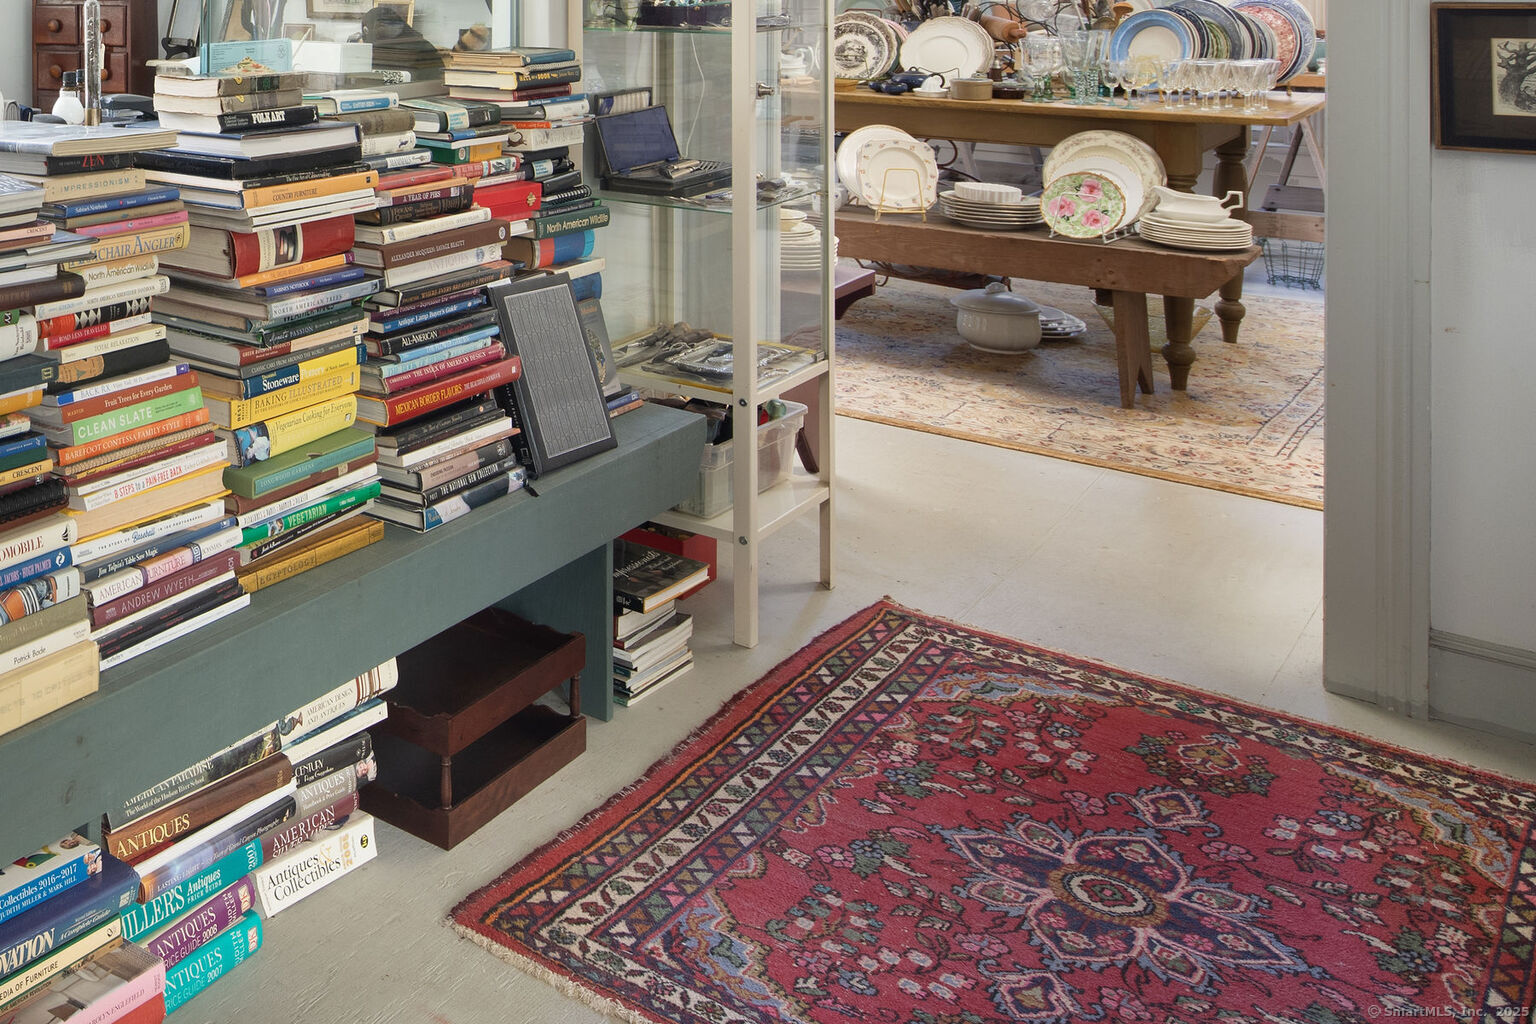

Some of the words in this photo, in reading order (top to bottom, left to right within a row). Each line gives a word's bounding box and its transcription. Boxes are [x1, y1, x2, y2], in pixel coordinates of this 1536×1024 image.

[252, 112, 270, 124] FOLK
[270, 110, 285, 122] ART
[82, 154, 105, 168] ZEN
[61, 177, 130, 193] IMPRESSIONISM
[273, 192, 293, 202] COUNTRY
[409, 193, 422, 202] YEAR
[429, 190, 441, 199] PIES
[547, 221, 562, 234] North
[563, 217, 590, 230] American
[590, 213, 609, 224] Wildlife
[88, 269, 105, 282] North
[107, 263, 134, 280] American
[274, 305, 293, 316] NORTH
[296, 298, 324, 310] AMERICAN
[326, 293, 343, 303] TREES
[83, 325, 108, 337] TRAVELED
[402, 330, 438, 347] ALL-AMERICAN
[447, 356, 469, 368] AMERICAN
[470, 351, 486, 362] DESIGN
[80, 388, 99, 398] BACK
[254, 390, 288, 409] BAKING
[289, 375, 343, 398] ILLUSTRATED
[262, 372, 300, 392] Stoneware
[104, 398, 117, 408] Fruit
[118, 394, 132, 404] Trees
[139, 388, 154, 400] Every
[154, 384, 173, 395] Garden
[395, 399, 419, 415] MEXICAN
[419, 391, 440, 407] BORDER
[440, 384, 462, 400] FLAVORS
[77, 419, 116, 439] CLEAN
[119, 407, 154, 426] SLATE
[275, 417, 302, 433] Vegetarian
[302, 409, 323, 425] Cooking
[330, 401, 353, 416] Everyone
[65, 443, 102, 461] BAREFOOT
[102, 434, 137, 452] CONTESSA
[137, 426, 161, 443] FAMILY
[162, 419, 181, 433] STYLE
[12, 464, 43, 479] CRESCENT
[119, 484, 135, 497] STEPS
[145, 471, 169, 487] PAIN-FREE
[170, 466, 183, 479] BACK
[288, 504, 327, 527] VEGETARIAN
[108, 540, 124, 549] STORY
[131, 528, 156, 544] Baseball
[4, 571, 20, 587] JACOBS
[22, 567, 34, 581] HUGH
[34, 559, 52, 576] PALMER
[108, 560, 124, 574] Tolpin's
[124, 557, 135, 568] Table
[144, 548, 158, 562] Magic
[99, 573, 143, 601] AMERICAN
[121, 587, 161, 613] ANDREW
[164, 574, 195, 595] WYETH
[14, 653, 31, 666] Patrick
[32, 647, 46, 659] Bade
[294, 759, 324, 777] CENTURY
[124, 778, 170, 808] AMERICAN
[171, 759, 214, 788] PARADISE
[300, 774, 345, 802] ANTIQUES
[125, 808, 134, 817] The
[134, 801, 148, 813] World
[161, 788, 178, 801] Hudson
[178, 784, 190, 794] River
[190, 777, 205, 789] School
[116, 813, 191, 859] ANTIQUES
[272, 805, 336, 852] AMERICAN
[187, 869, 221, 897] Antiques
[268, 852, 319, 890] Antiques
[274, 857, 341, 902] Collectibles
[0, 907, 20, 921] JUDITH
[21, 896, 42, 912] MILLER
[48, 883, 64, 896] MARK
[64, 876, 77, 889] HILL
[187, 890, 204, 905] PRICE
[204, 879, 222, 895] GUIDE
[92, 909, 111, 925] Guide
[156, 906, 216, 958] ANTIQUES
[180, 939, 202, 958] GUIDE
[15, 981, 24, 992] OF
[25, 960, 59, 985] FURNITURE
[183, 979, 206, 999] GUIDE
[207, 964, 223, 983] 2007
